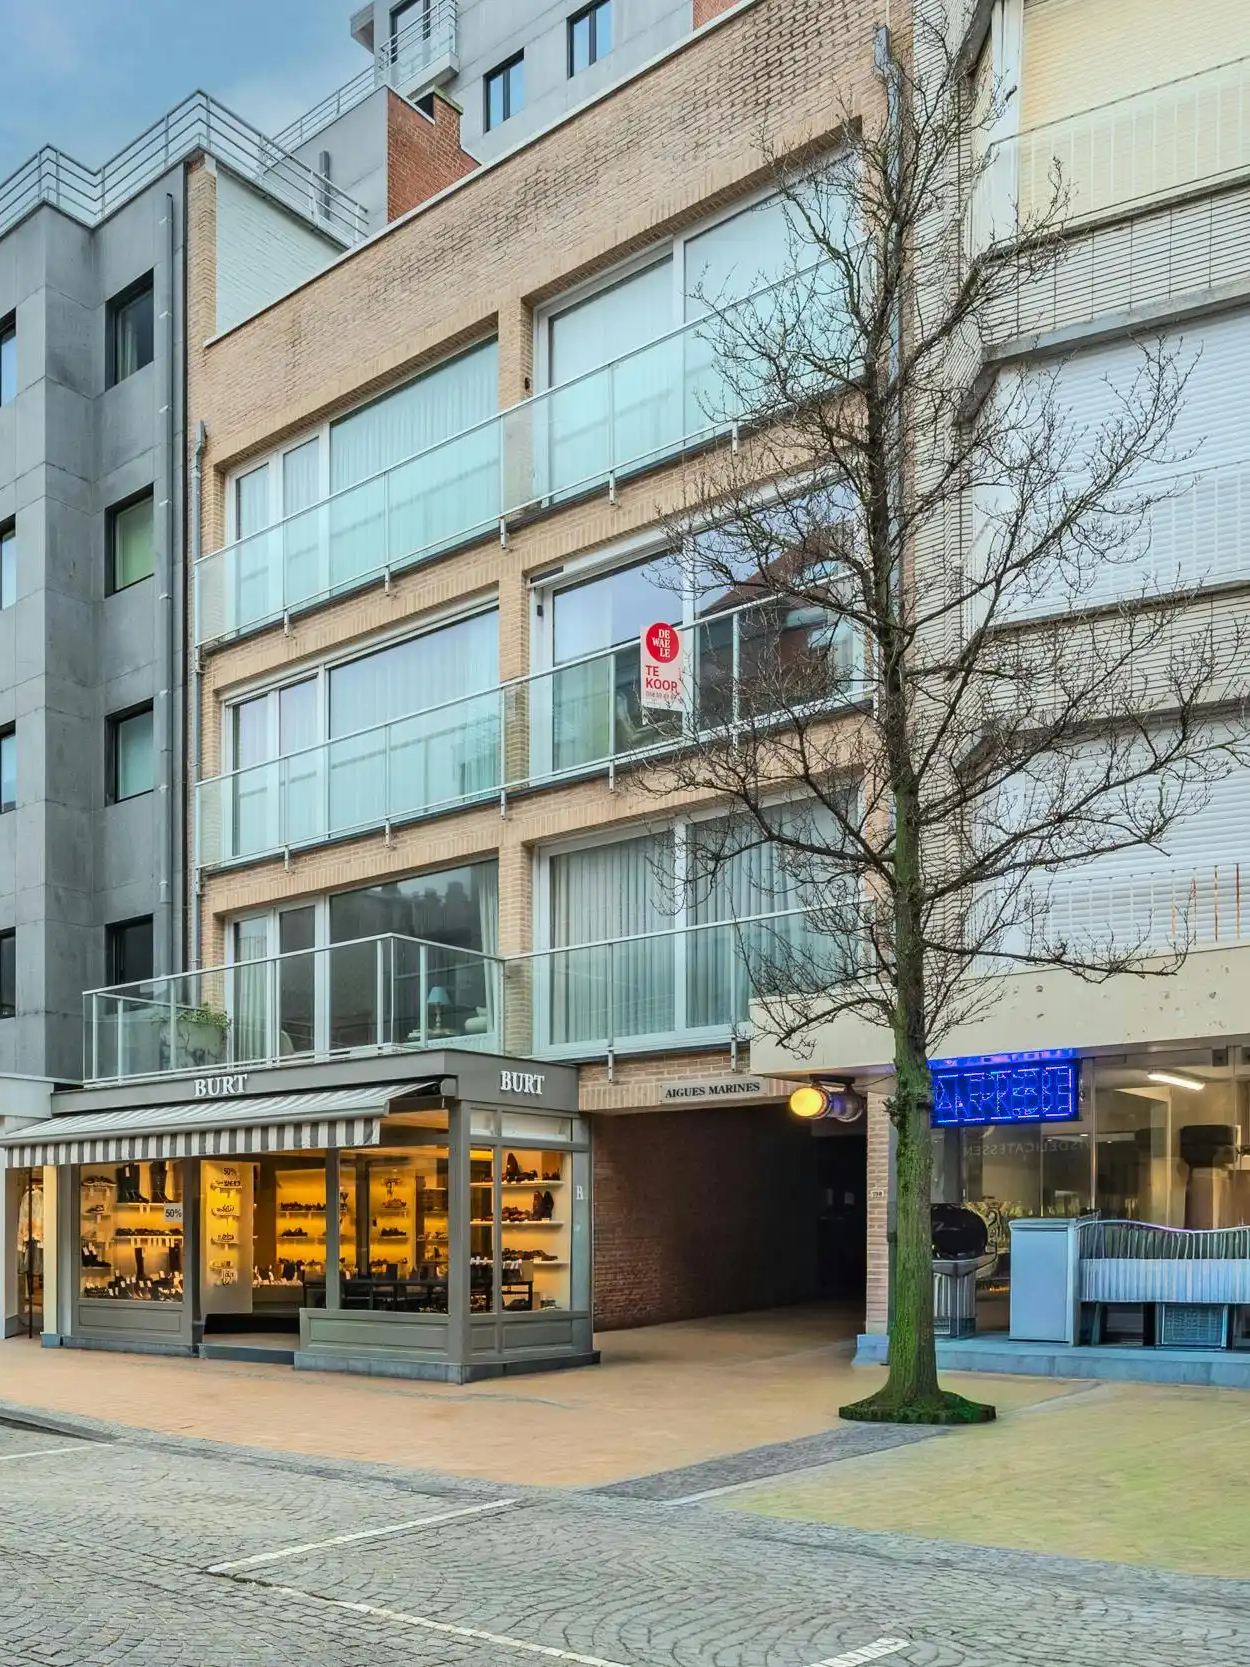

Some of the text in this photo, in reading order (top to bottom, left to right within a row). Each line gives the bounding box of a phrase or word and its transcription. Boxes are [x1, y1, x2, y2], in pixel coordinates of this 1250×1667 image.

[659, 629, 670, 639] DE
[652, 637, 670, 648] WAE
[660, 648, 670, 658] LE
[646, 665, 659, 677] TE
[646, 678, 678, 691] KOOP
[194, 1073, 248, 1097] BURT
[500, 1070, 545, 1095] BURT
[665, 1082, 760, 1098] AIGUES MARINES
[165, 1208, 183, 1219] 50%
